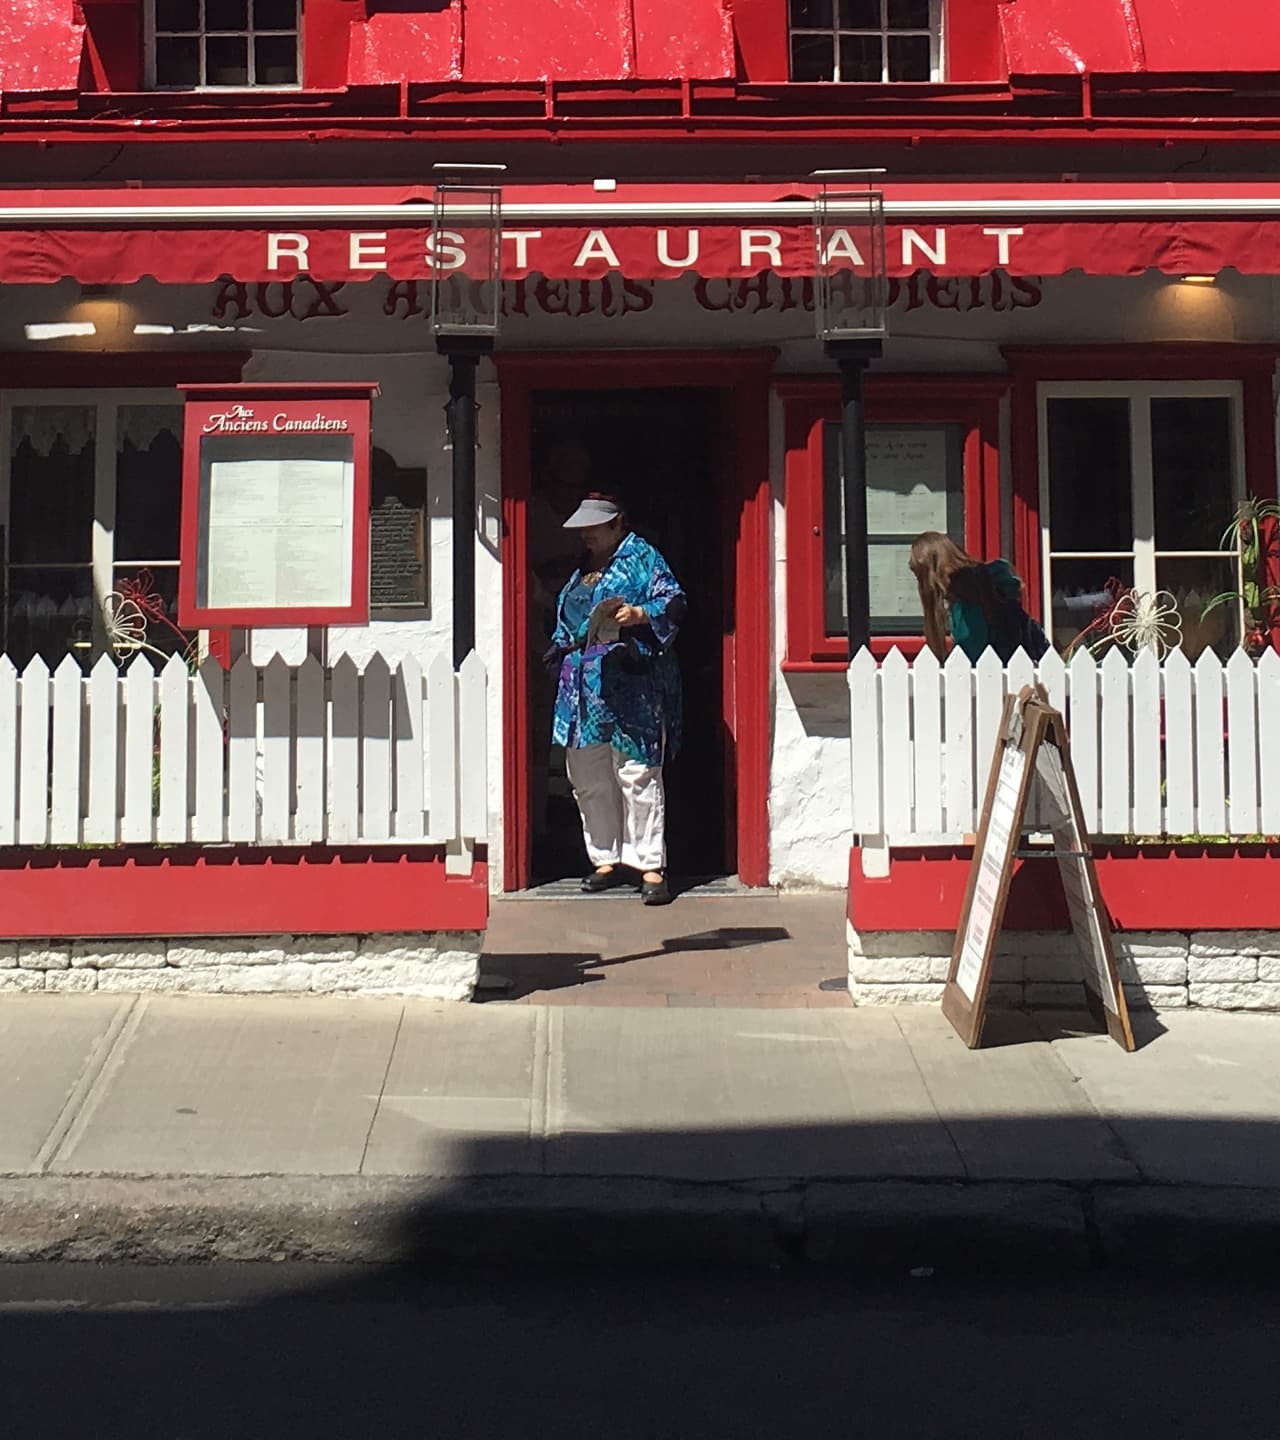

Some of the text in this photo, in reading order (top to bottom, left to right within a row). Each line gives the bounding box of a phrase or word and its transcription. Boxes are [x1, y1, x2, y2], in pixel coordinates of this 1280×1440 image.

[267, 227, 1025, 270] RESTAURANT
[225, 404, 255, 419] Aux
[203, 412, 349, 433] Anciens Canadiens
